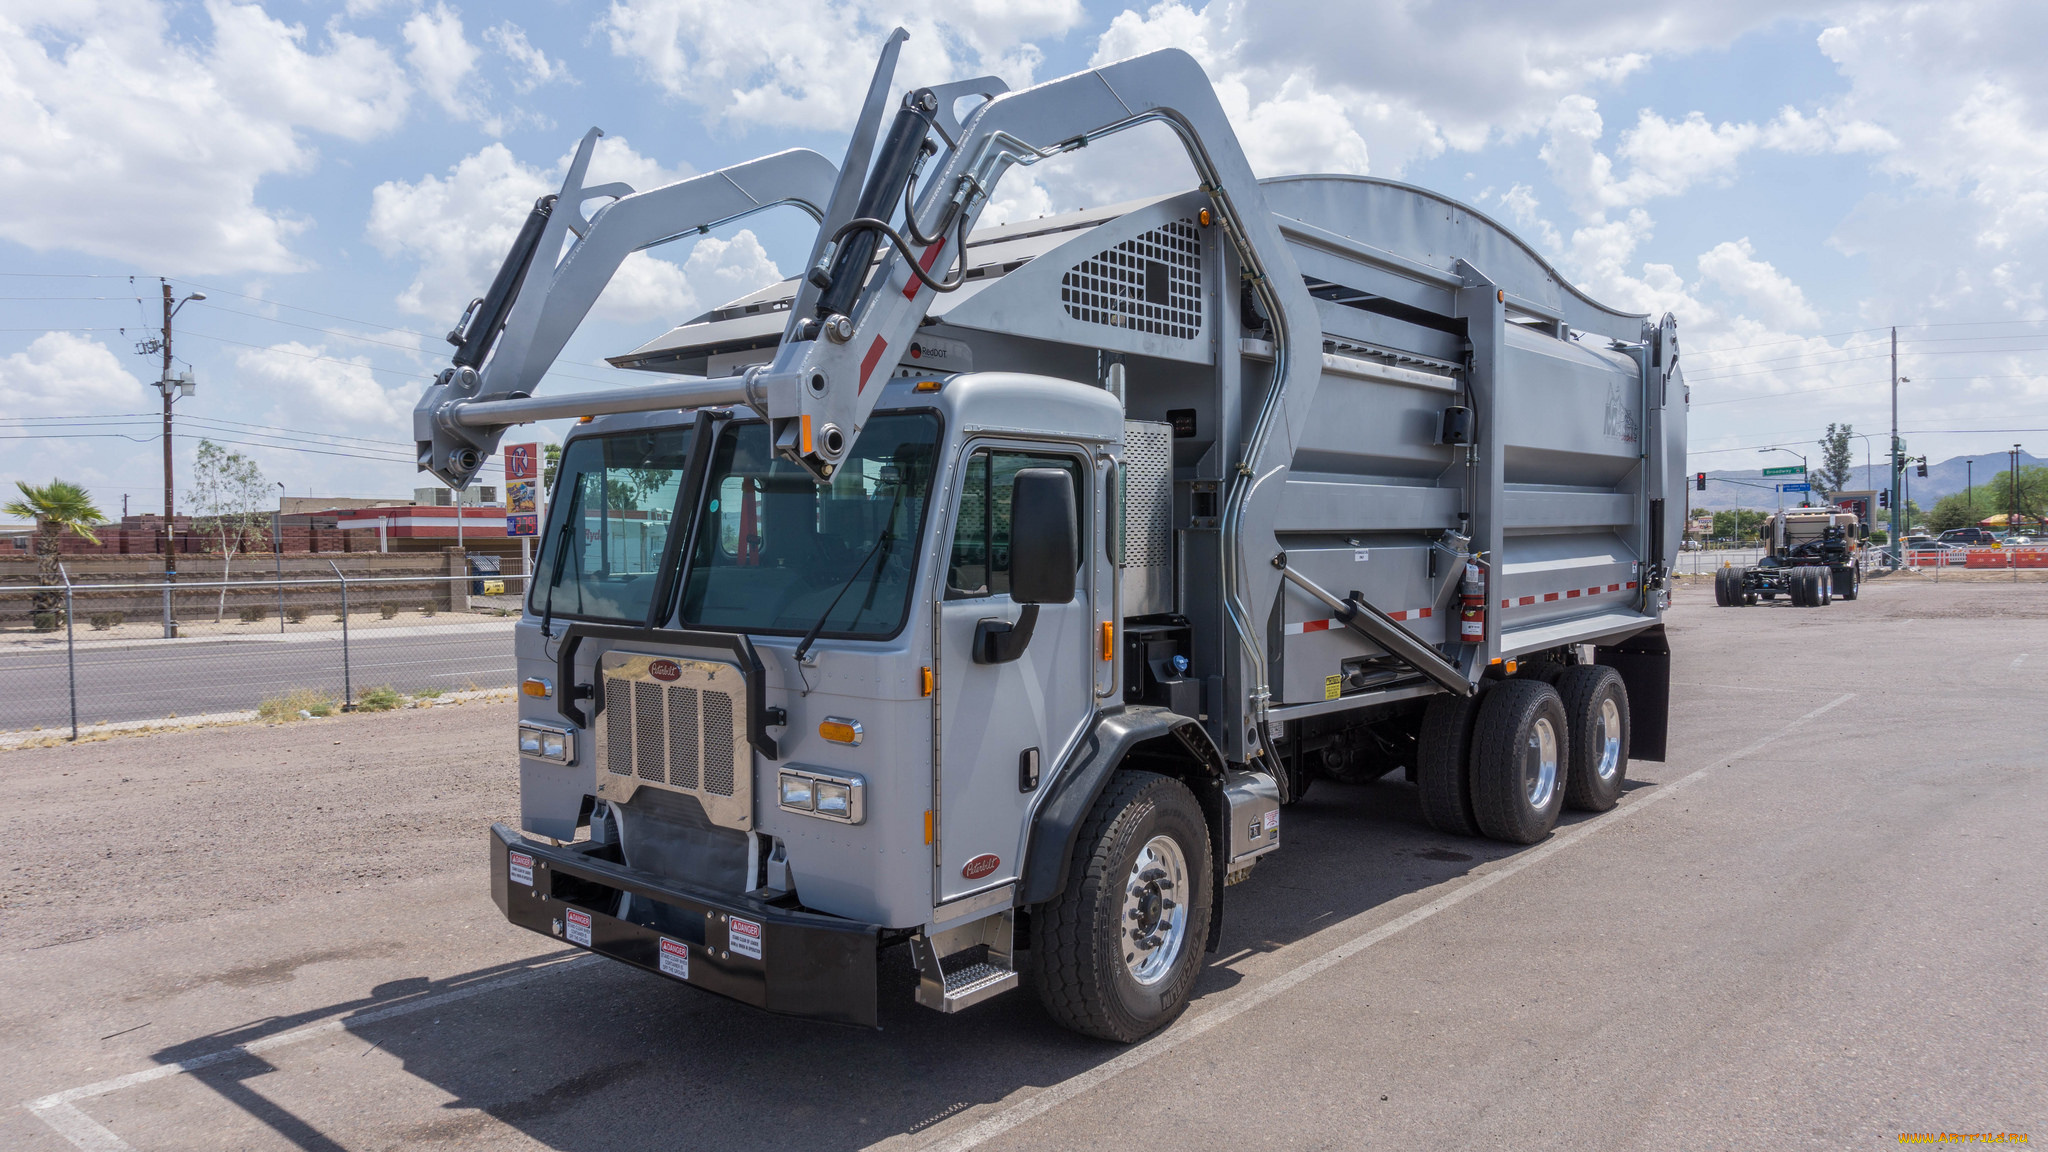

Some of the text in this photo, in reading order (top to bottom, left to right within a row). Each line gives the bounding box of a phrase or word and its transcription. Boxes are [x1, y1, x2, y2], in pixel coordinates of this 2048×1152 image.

[651, 662, 677, 676] Peterbilt
[515, 856, 530, 866] DANGER
[966, 857, 998, 877] Peterbilt
[572, 913, 589, 925] DANGER
[737, 922, 758, 936] DANGER
[666, 943, 686, 956] DANGER
